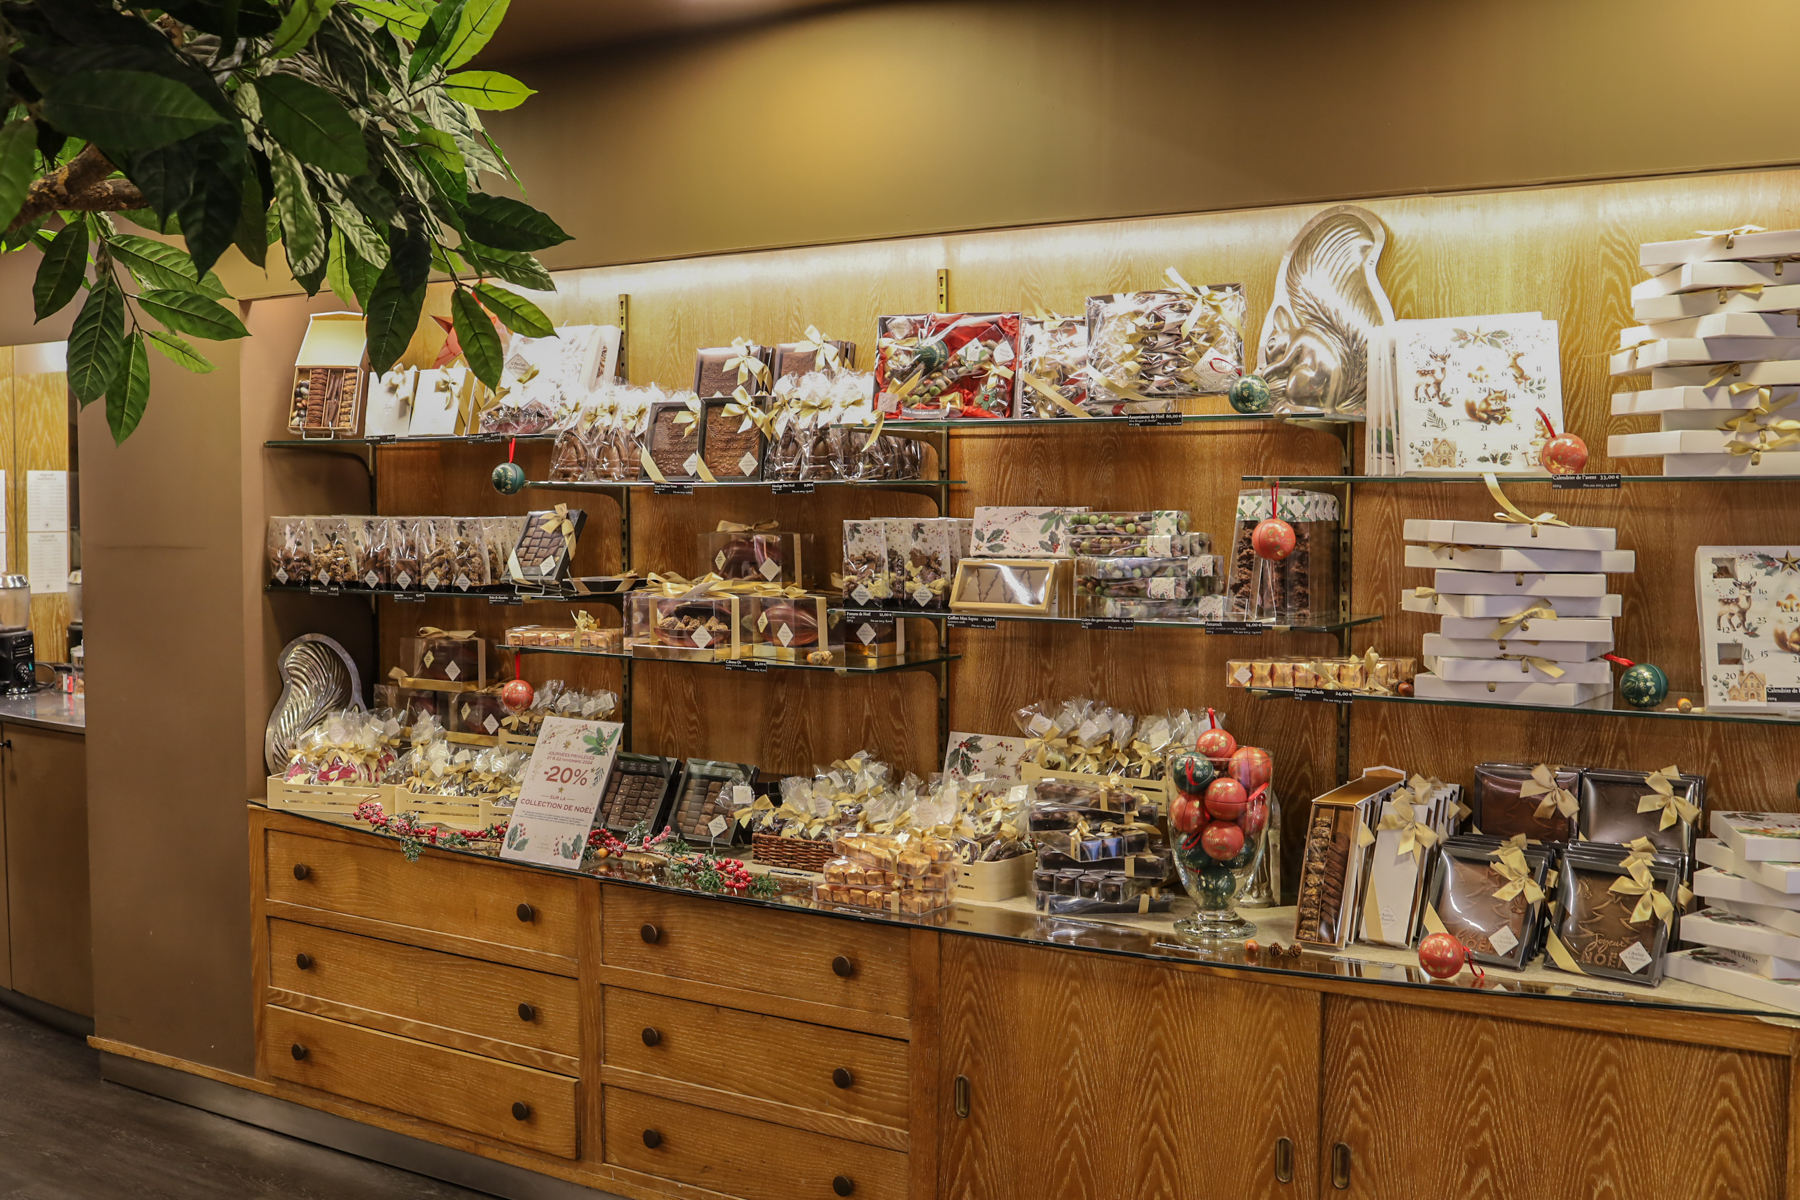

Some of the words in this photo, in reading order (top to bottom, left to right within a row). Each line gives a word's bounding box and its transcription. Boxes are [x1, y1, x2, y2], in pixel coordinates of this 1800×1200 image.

[1757, 616, 1767, 624] 23
[1760, 650, 1769, 658] 15
[544, 765, 589, 786] -20%
[520, 798, 563, 809] COLLECTION
[1737, 951, 1758, 965] L'AVENT
